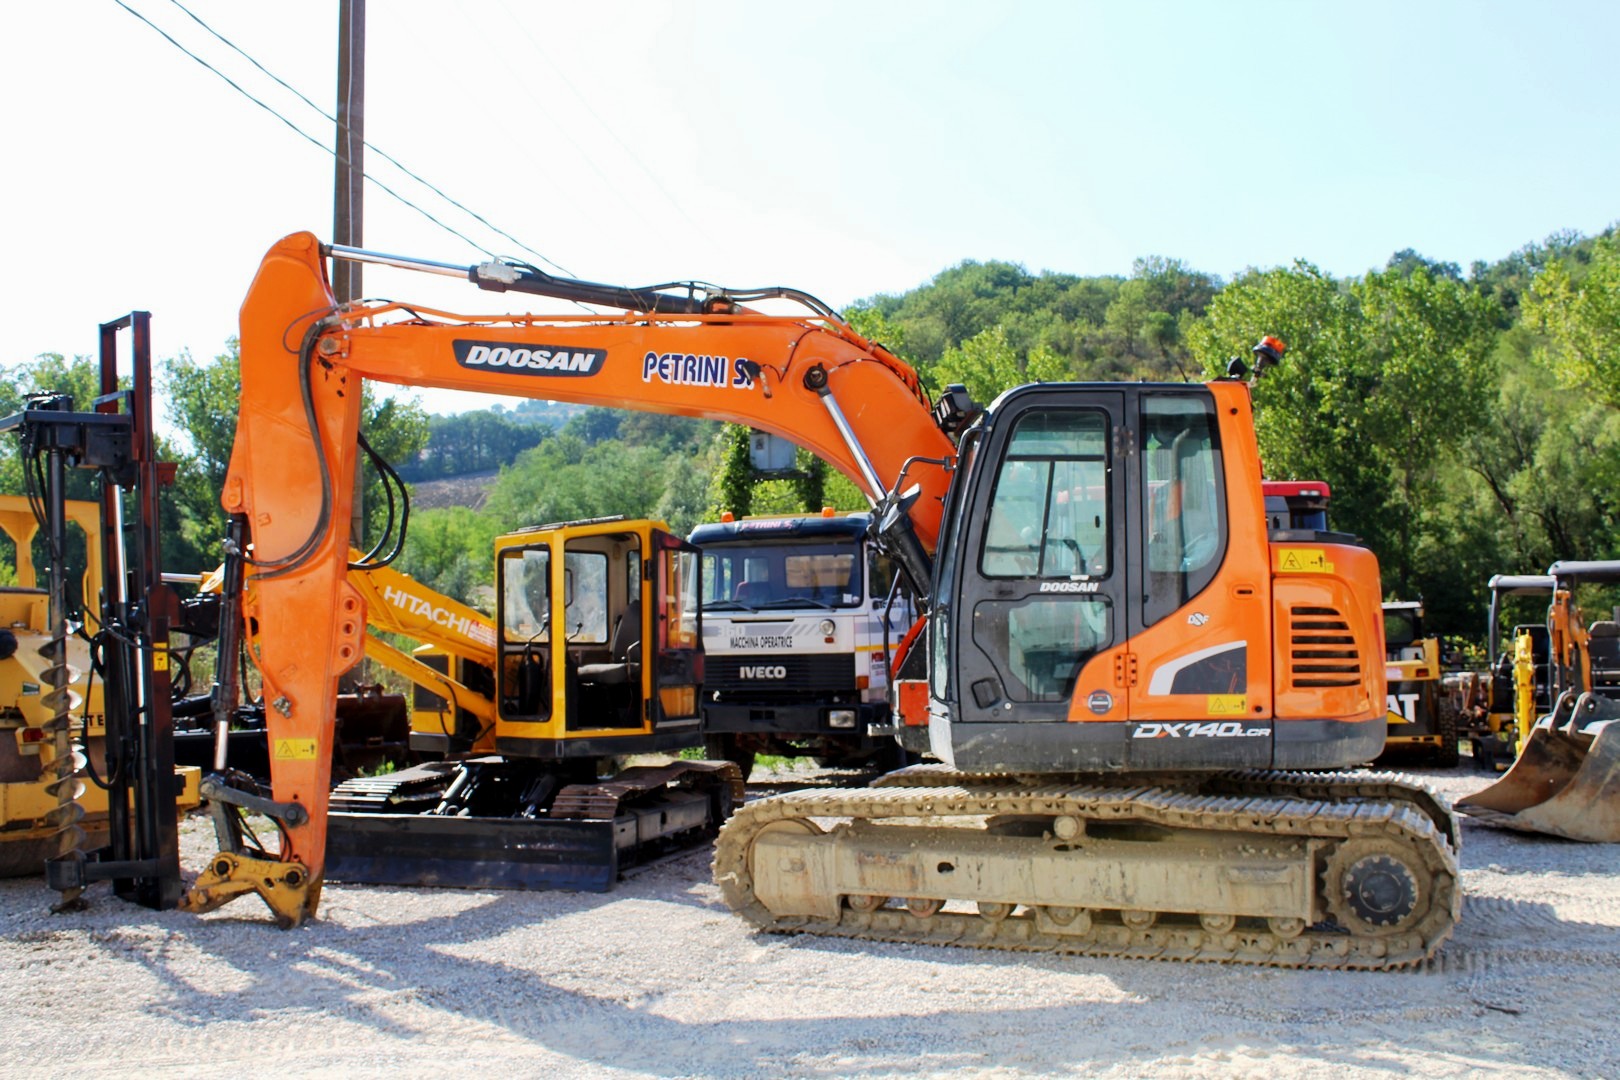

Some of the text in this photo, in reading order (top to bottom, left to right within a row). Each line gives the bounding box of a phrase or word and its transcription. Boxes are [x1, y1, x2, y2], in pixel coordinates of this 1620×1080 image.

[465, 345, 596, 373] DOOSAN
[642, 351, 729, 388] PETRINI
[1039, 582, 1099, 592] DOOSAN
[383, 585, 473, 635] HITACHI
[730, 635, 792, 648] MACCHINA OPERATRICE
[739, 665, 787, 679] IVECO
[1386, 693, 1419, 723] AT
